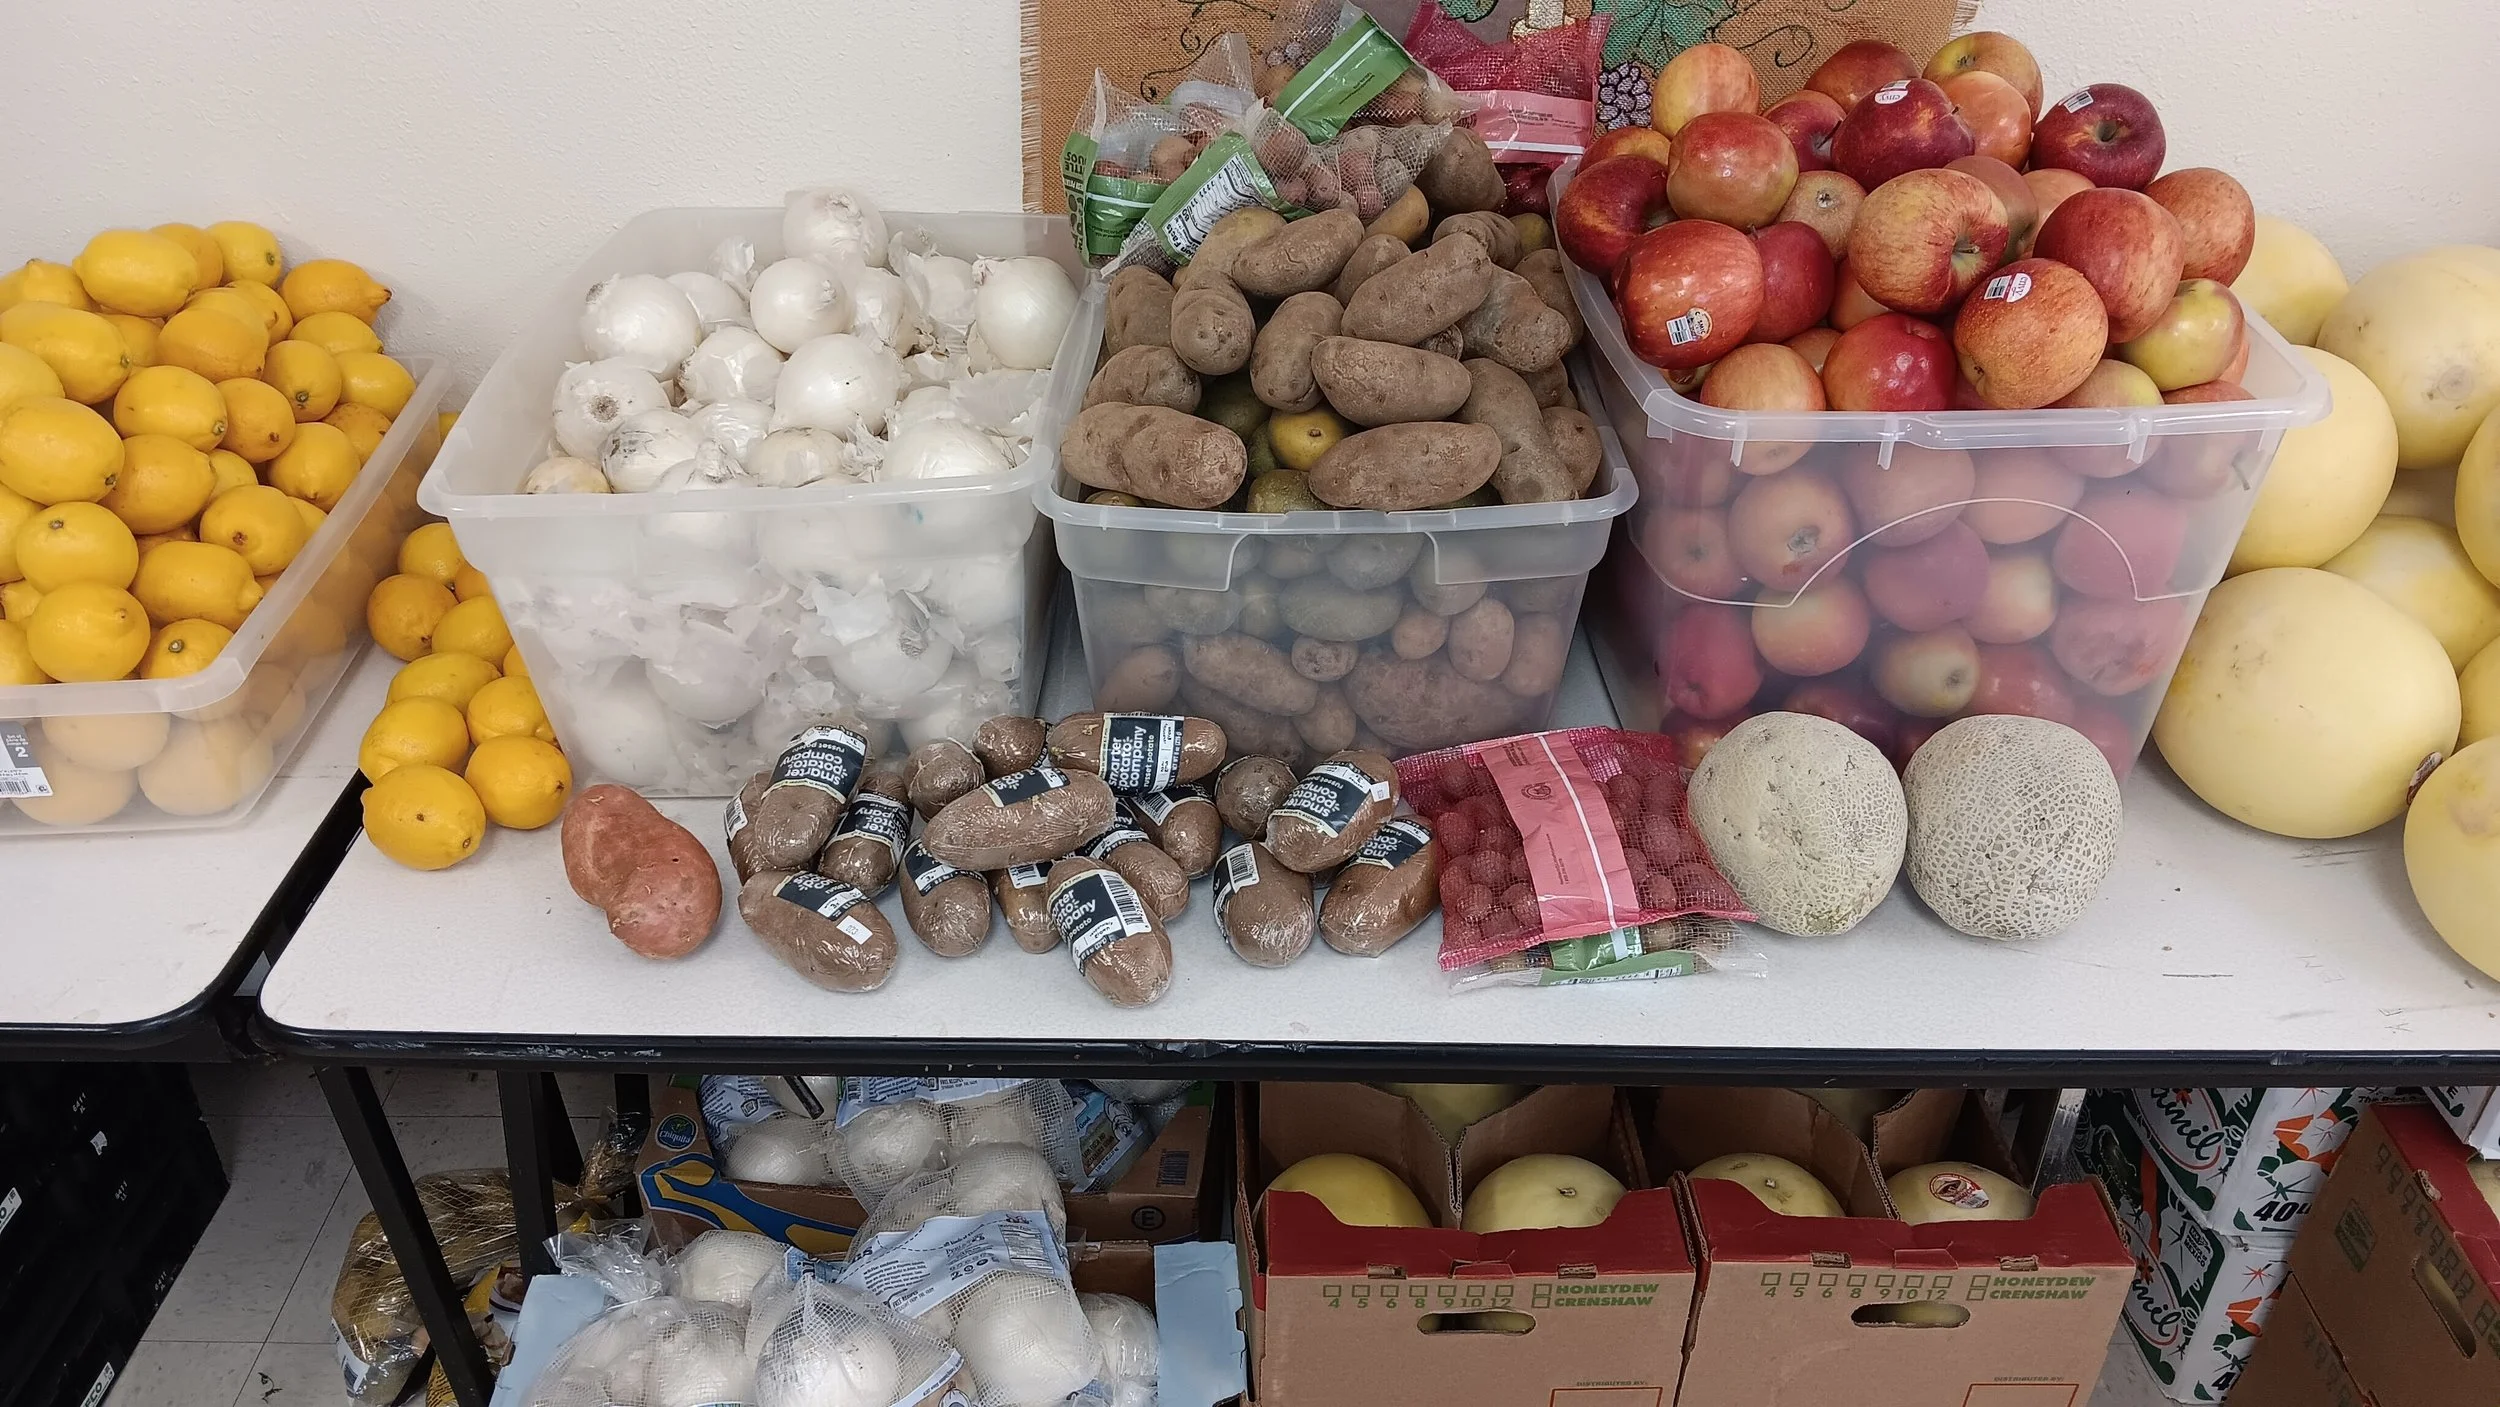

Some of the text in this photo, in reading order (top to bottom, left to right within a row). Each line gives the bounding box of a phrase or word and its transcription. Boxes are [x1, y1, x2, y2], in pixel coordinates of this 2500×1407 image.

[15, 747, 28, 758] 2
[818, 743, 845, 753] russet
[780, 749, 843, 767] company
[1109, 737, 1122, 786] smarter
[1119, 742, 1132, 787] potato
[1130, 726, 1147, 787] company
[1144, 734, 1155, 788] russet potato
[793, 760, 843, 776] potato
[785, 768, 841, 786] smarter
[1068, 917, 1092, 940] potato
[659, 1130, 691, 1145] Chiquita
[1142, 1211, 1155, 1227] E
[2184, 1240, 2206, 1267] MEXICO
[1556, 1284, 1660, 1294] HONEYDEW
[1993, 1276, 2096, 1287] HONEYDEW
[1765, 1286, 1946, 1300] 4 5 6 8 9 10 12
[1989, 1289, 2088, 1300] CRENSHAW
[1328, 1297, 1511, 1308] 4 5 6 8 9 10 12
[1554, 1296, 1654, 1307] CRENSHAW
